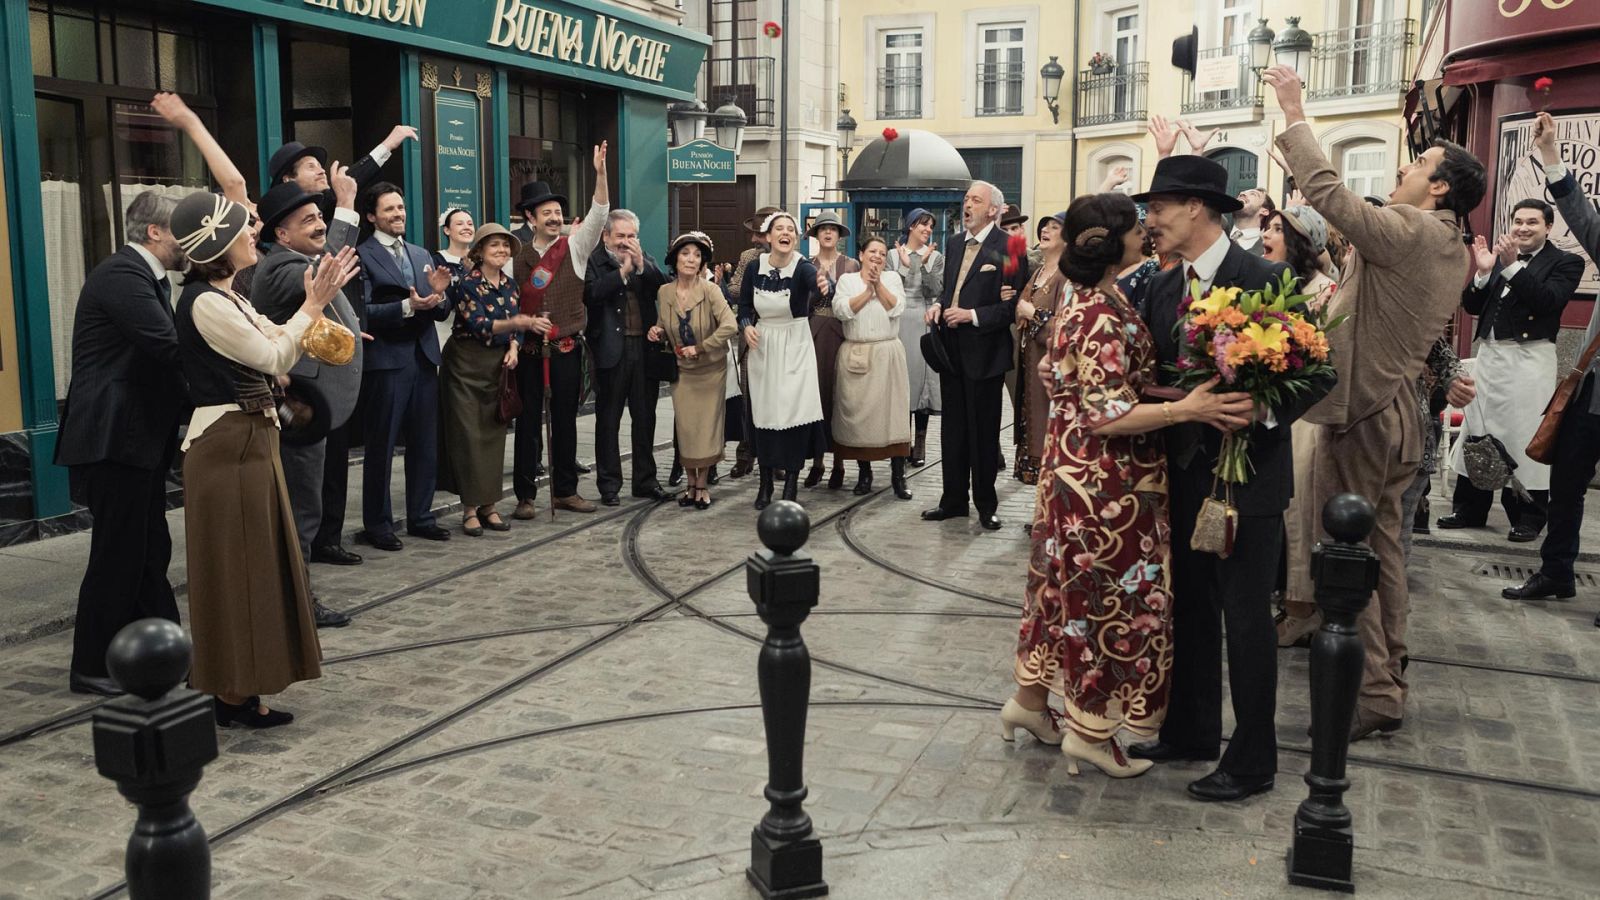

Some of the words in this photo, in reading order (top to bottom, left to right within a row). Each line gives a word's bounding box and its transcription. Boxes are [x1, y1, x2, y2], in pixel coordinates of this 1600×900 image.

[487, 0, 583, 64] BUENA
[586, 14, 671, 82] NOCHE
[1217, 131, 1228, 143] 34
[438, 144, 458, 156] BUENA
[672, 158, 702, 170] BUENA
[703, 159, 732, 170] NOCHE
[1529, 142, 1596, 187] NEVO
